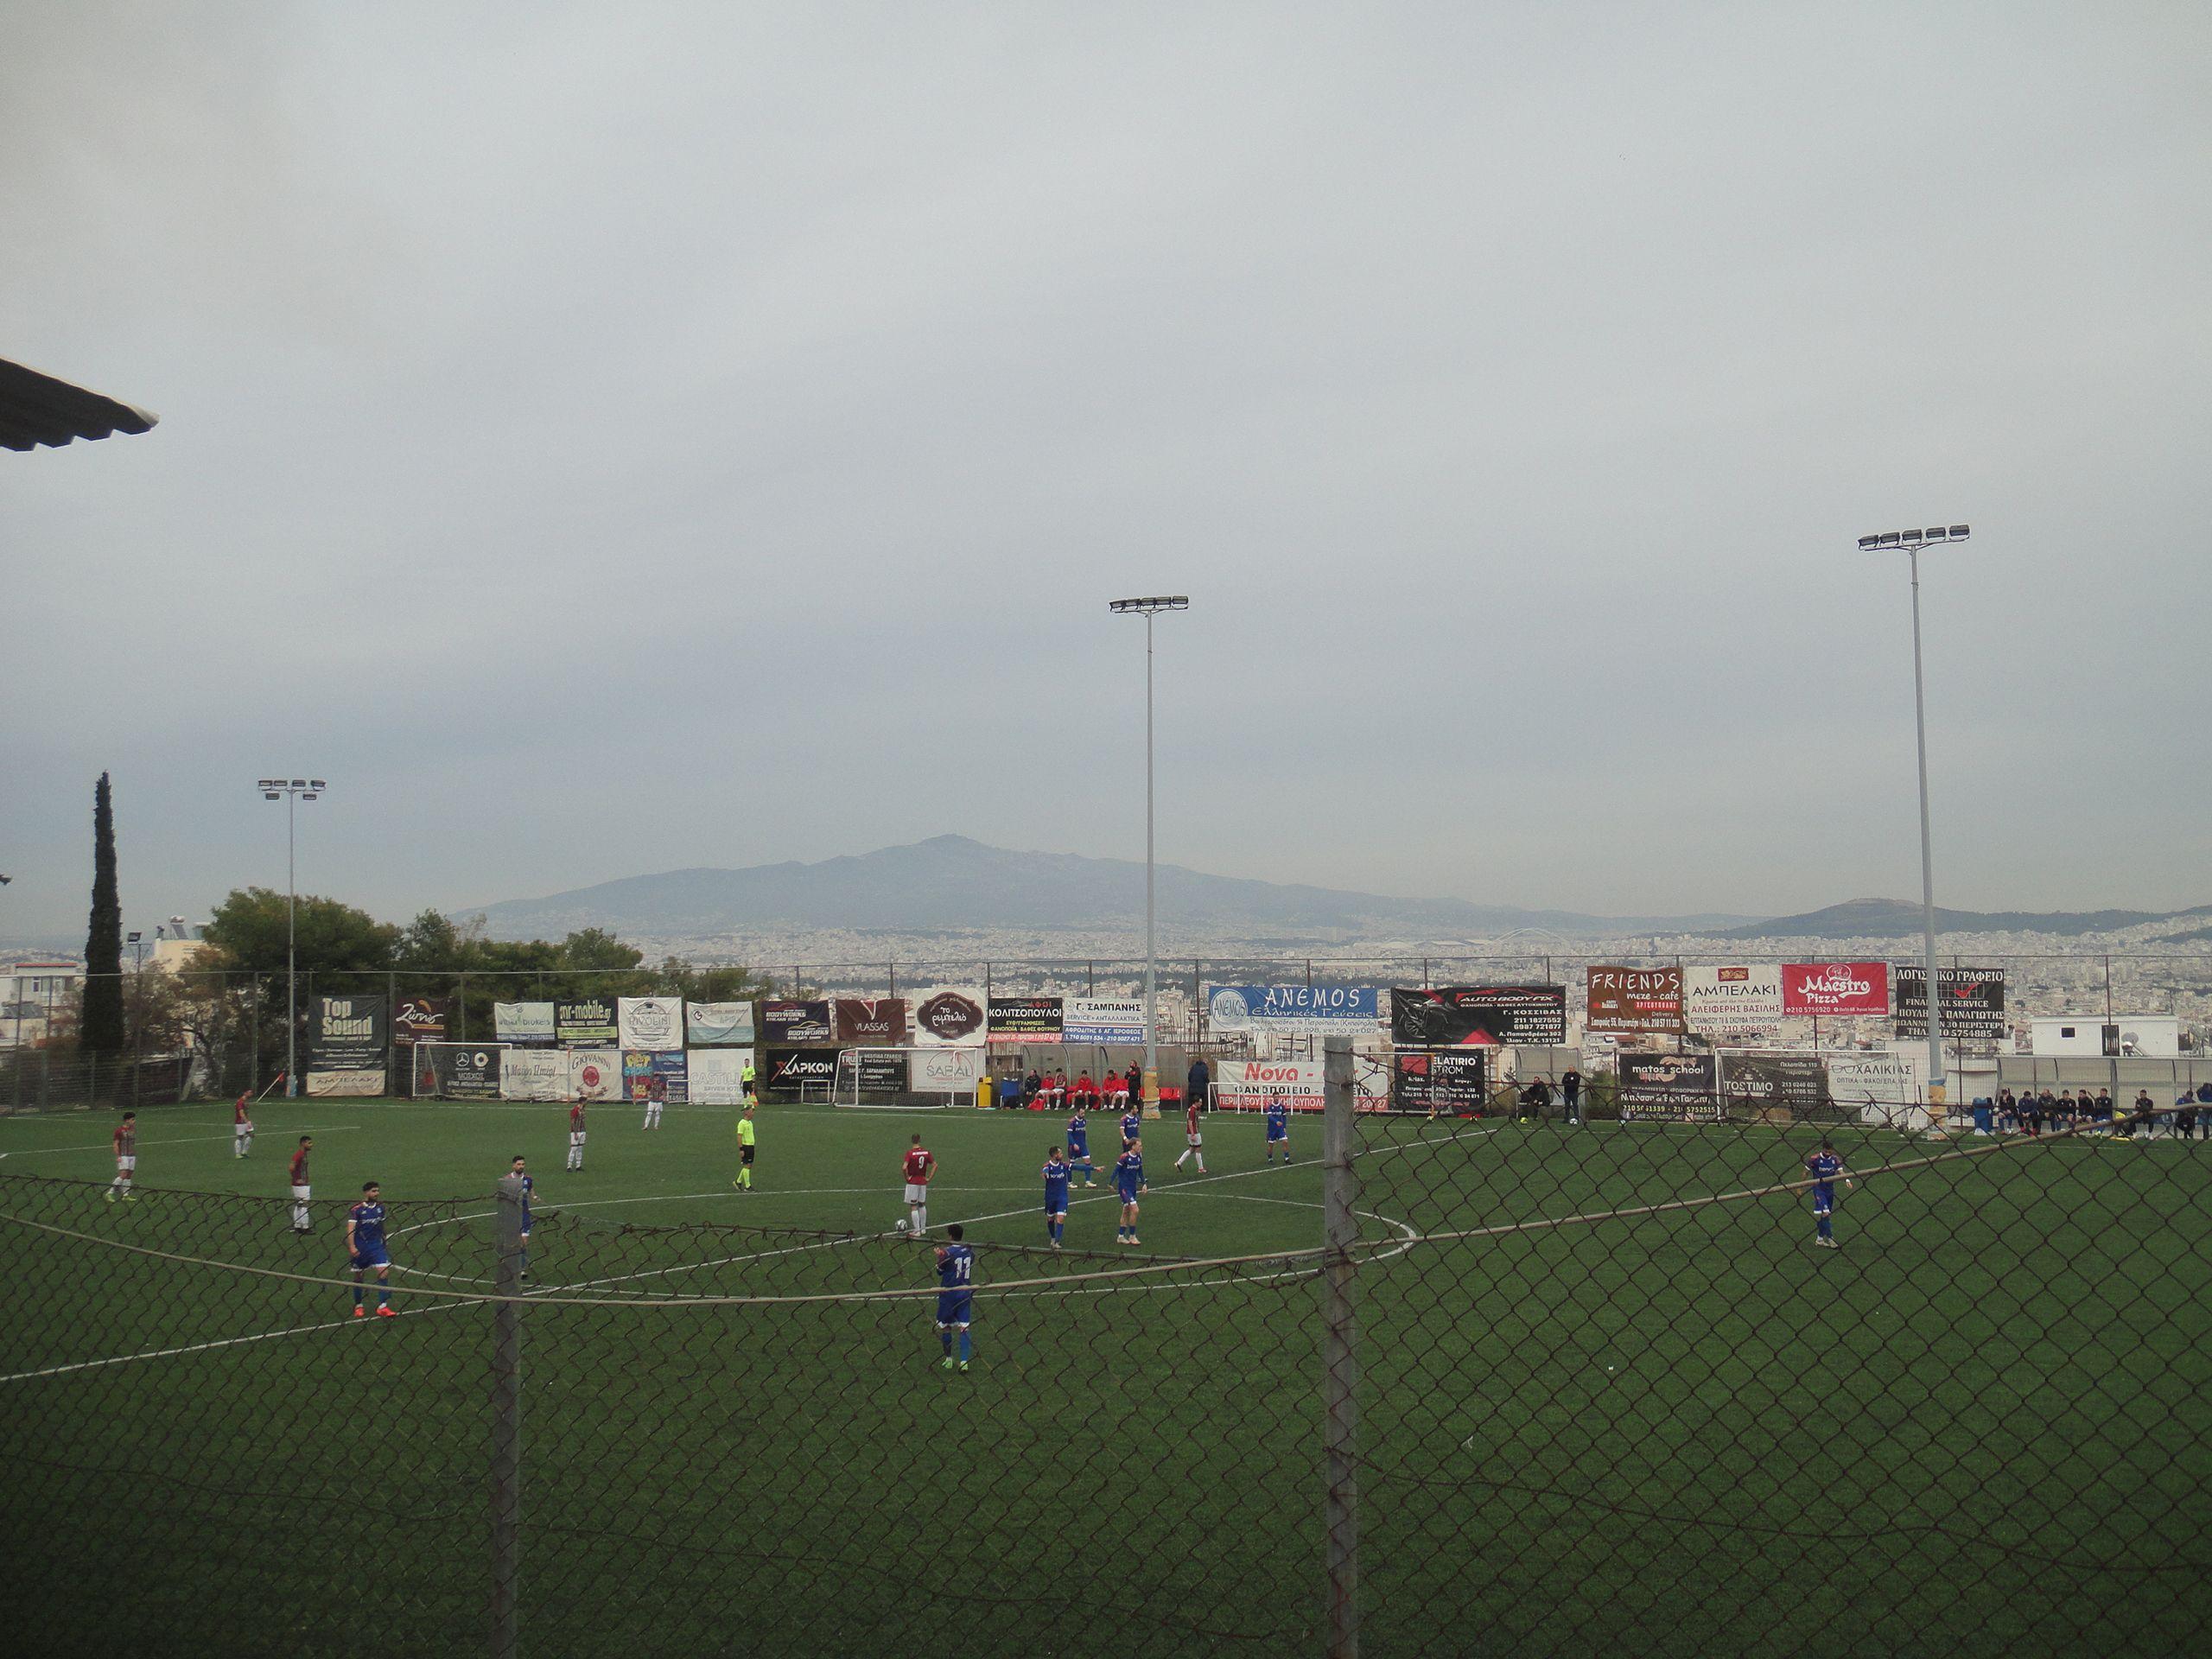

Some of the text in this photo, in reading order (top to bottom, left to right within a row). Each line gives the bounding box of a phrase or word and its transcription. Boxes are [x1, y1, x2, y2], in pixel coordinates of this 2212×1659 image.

[1592, 973, 1680, 989] FRIENDS
[1897, 969, 2004, 982] ΛΟΓΙΣΙΚΟ ΓΡΑΦΕΙΟ
[1693, 985, 1777, 996] ΑΜΠΕΛΑΚΙ
[1798, 976, 1871, 995] Maestro
[1263, 988, 1360, 1008] ANEMOS
[1659, 990, 1680, 1000] cafe
[1806, 993, 1839, 1003] Pizza
[322, 998, 352, 1018] Top
[1088, 1003, 1141, 1012] ΣΑΜΠΑΝΗΣ
[1905, 998, 1951, 1007] FINAIAL
[988, 1008, 1062, 1017] ΚΟΛΙΤΣΟΠΟΥΛΟΙ
[1214, 999, 1245, 1018] ANEMOS
[1252, 1007, 1374, 1018] Ελληνικές Γεύσεις
[1946, 1010, 2005, 1020] ΠΑΝΑΓΙΩΤΗΣ
[322, 1016, 372, 1035] Sound
[855, 1021, 889, 1032] VLASSAS
[1906, 1027, 1929, 1036] ΤΗΛ.
[1950, 1029, 1993, 1038] 5754885
[1244, 1061, 1299, 1081] Nova
[1632, 1065, 1704, 1074] matos school
[1724, 1081, 1774, 1091] TOSTIMO
[918, 1155, 925, 1169] 9
[954, 1256, 971, 1279] 11
